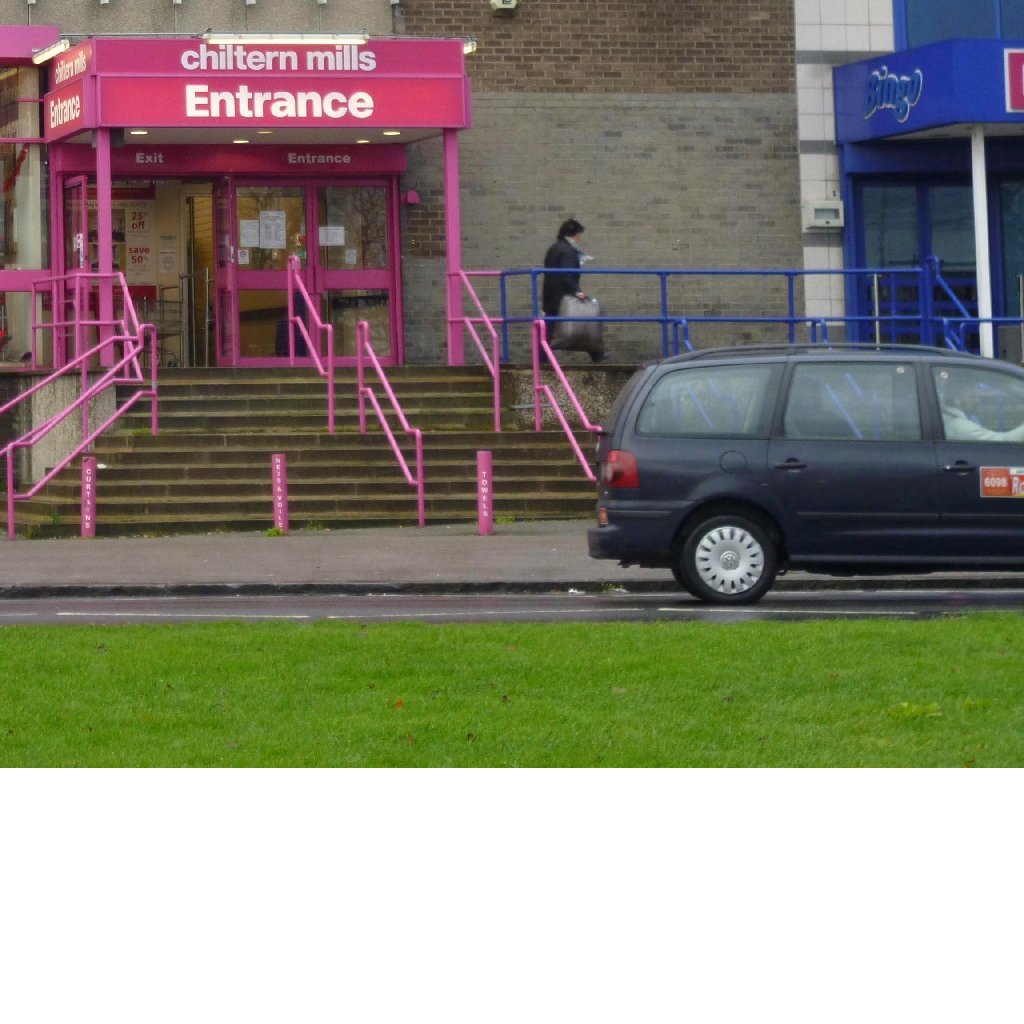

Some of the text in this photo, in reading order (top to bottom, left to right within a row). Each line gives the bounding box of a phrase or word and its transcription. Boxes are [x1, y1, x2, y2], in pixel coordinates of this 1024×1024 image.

[181, 44, 377, 72] chiltern mills
[184, 84, 374, 119] Entrance
[864, 65, 923, 123] Bingo
[50, 95, 81, 129] Entrance
[135, 152, 165, 164] Exit
[288, 152, 351, 164] Entrance
[131, 220, 145, 229] off
[481, 471, 489, 517] TOWELS
